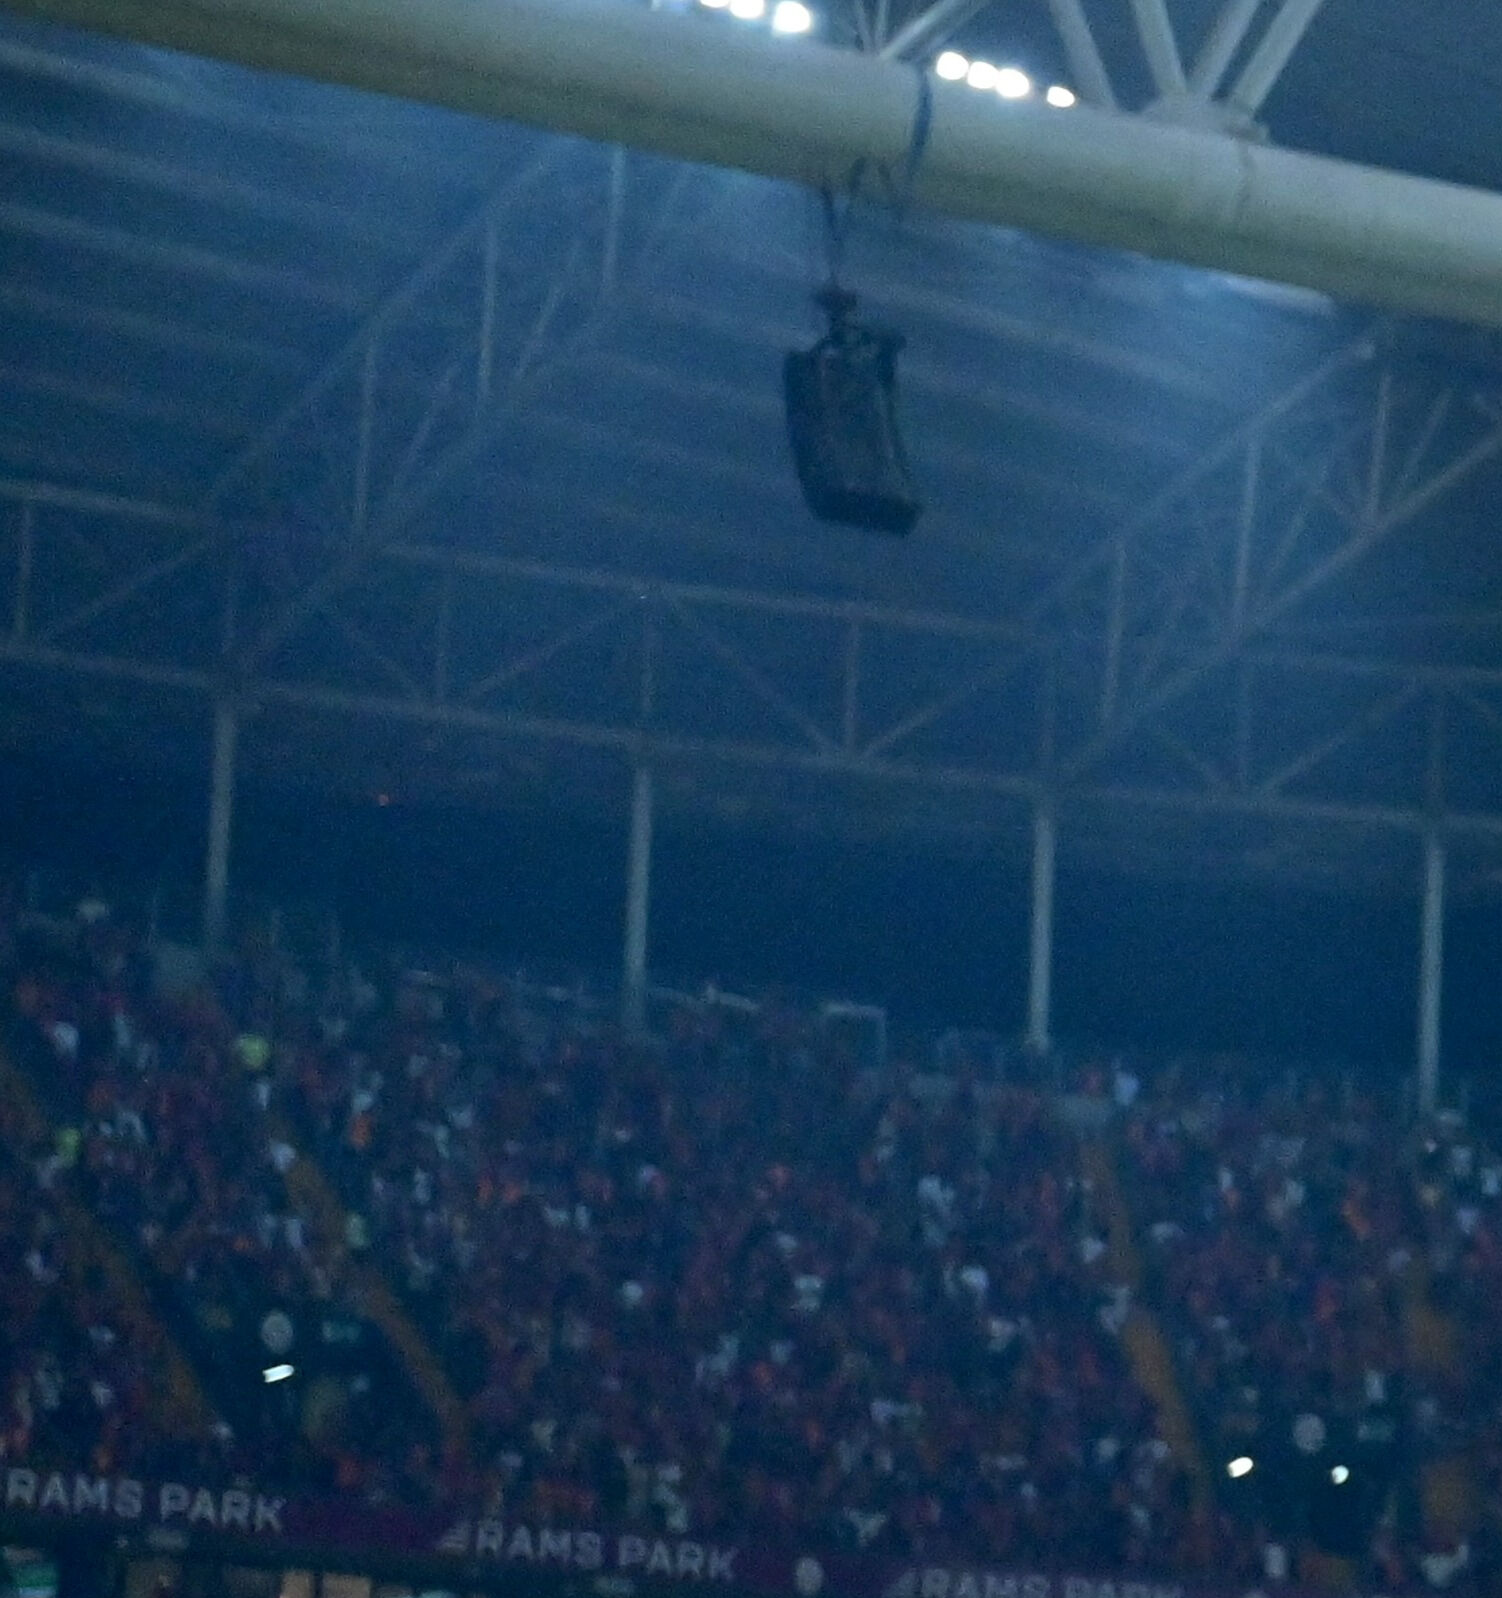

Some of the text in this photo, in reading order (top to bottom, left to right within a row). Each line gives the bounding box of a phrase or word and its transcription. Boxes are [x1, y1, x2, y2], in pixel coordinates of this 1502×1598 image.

[7, 1467, 286, 1532] RAMS PARK
[476, 1519, 736, 1581] RAMS PARK
